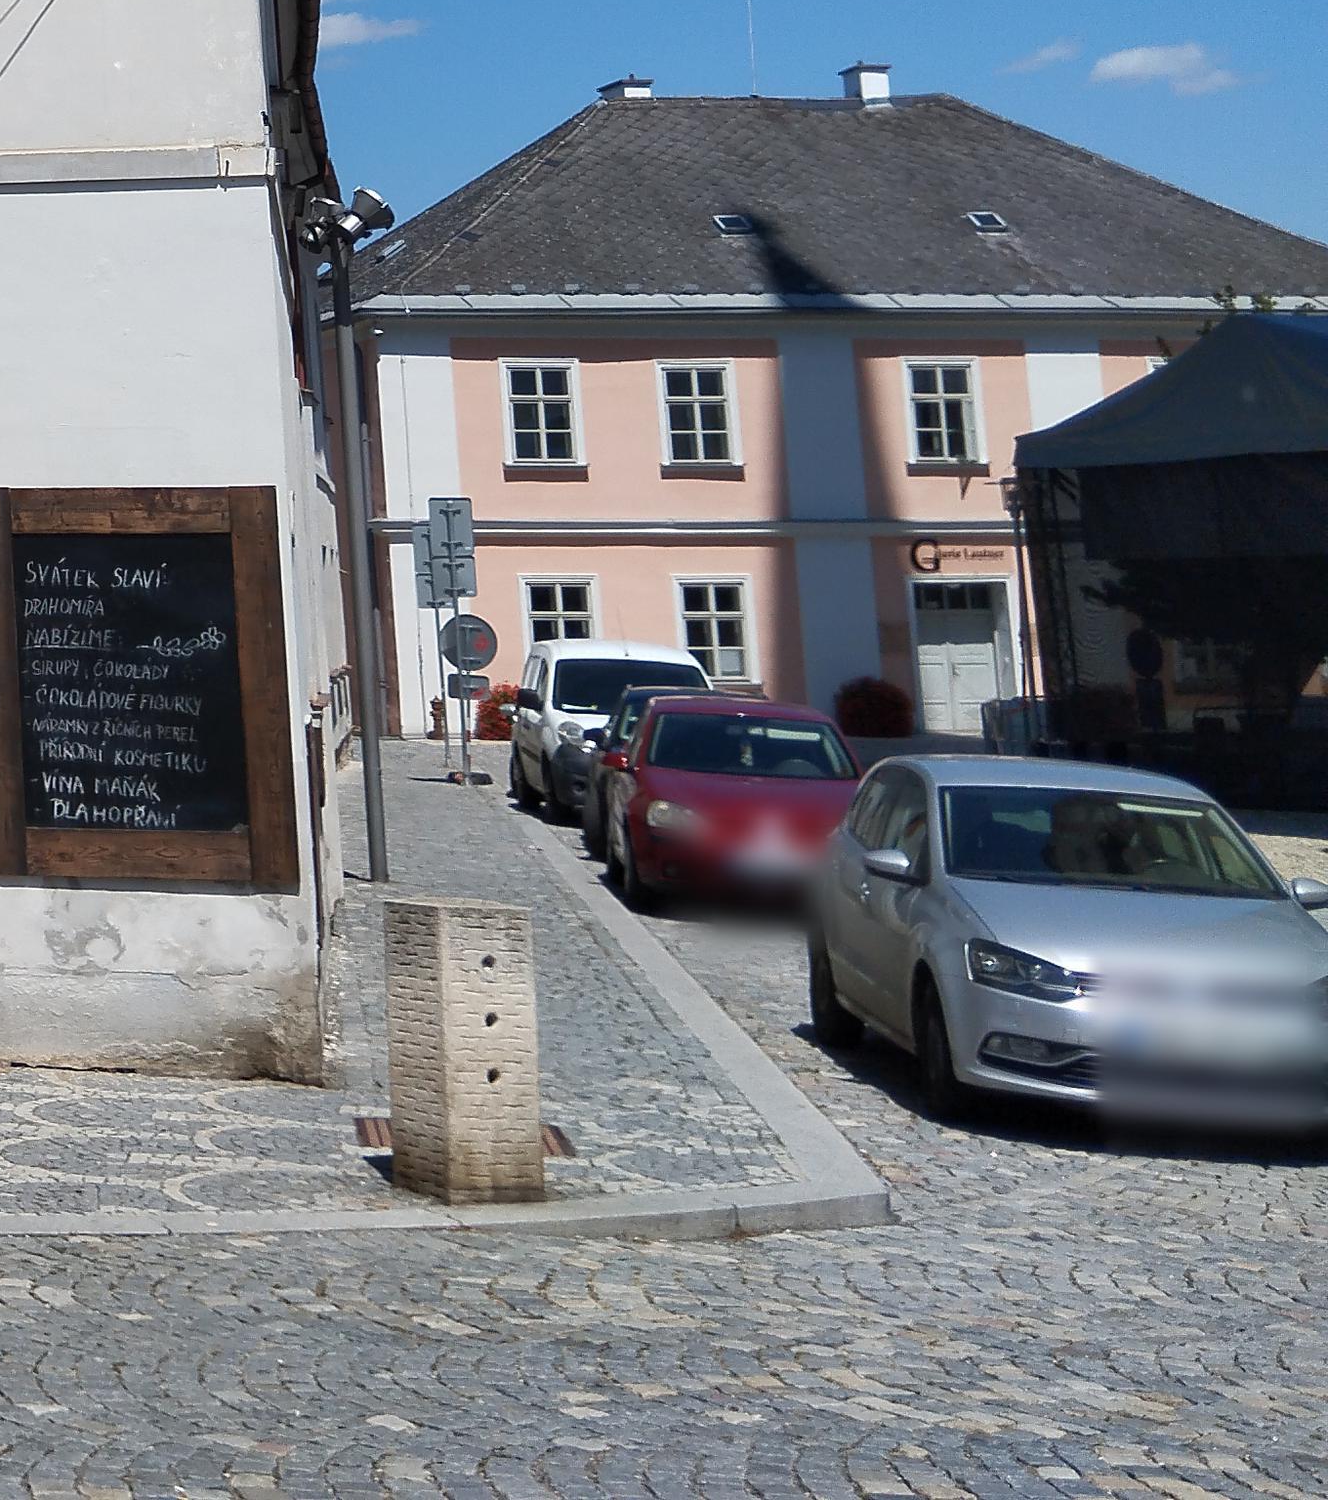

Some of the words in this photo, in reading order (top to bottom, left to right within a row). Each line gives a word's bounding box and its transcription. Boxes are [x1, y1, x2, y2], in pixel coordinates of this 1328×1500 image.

[25, 557, 101, 588] SVÁTEK
[24, 595, 104, 618] DRAHOMÍRA
[139, 693, 202, 717] FIGURKY
[156, 723, 198, 743] PEREL
[114, 749, 206, 773] KOSMETIKU
[42, 768, 85, 794] VÍNA
[95, 773, 161, 802] MAŇÁK
